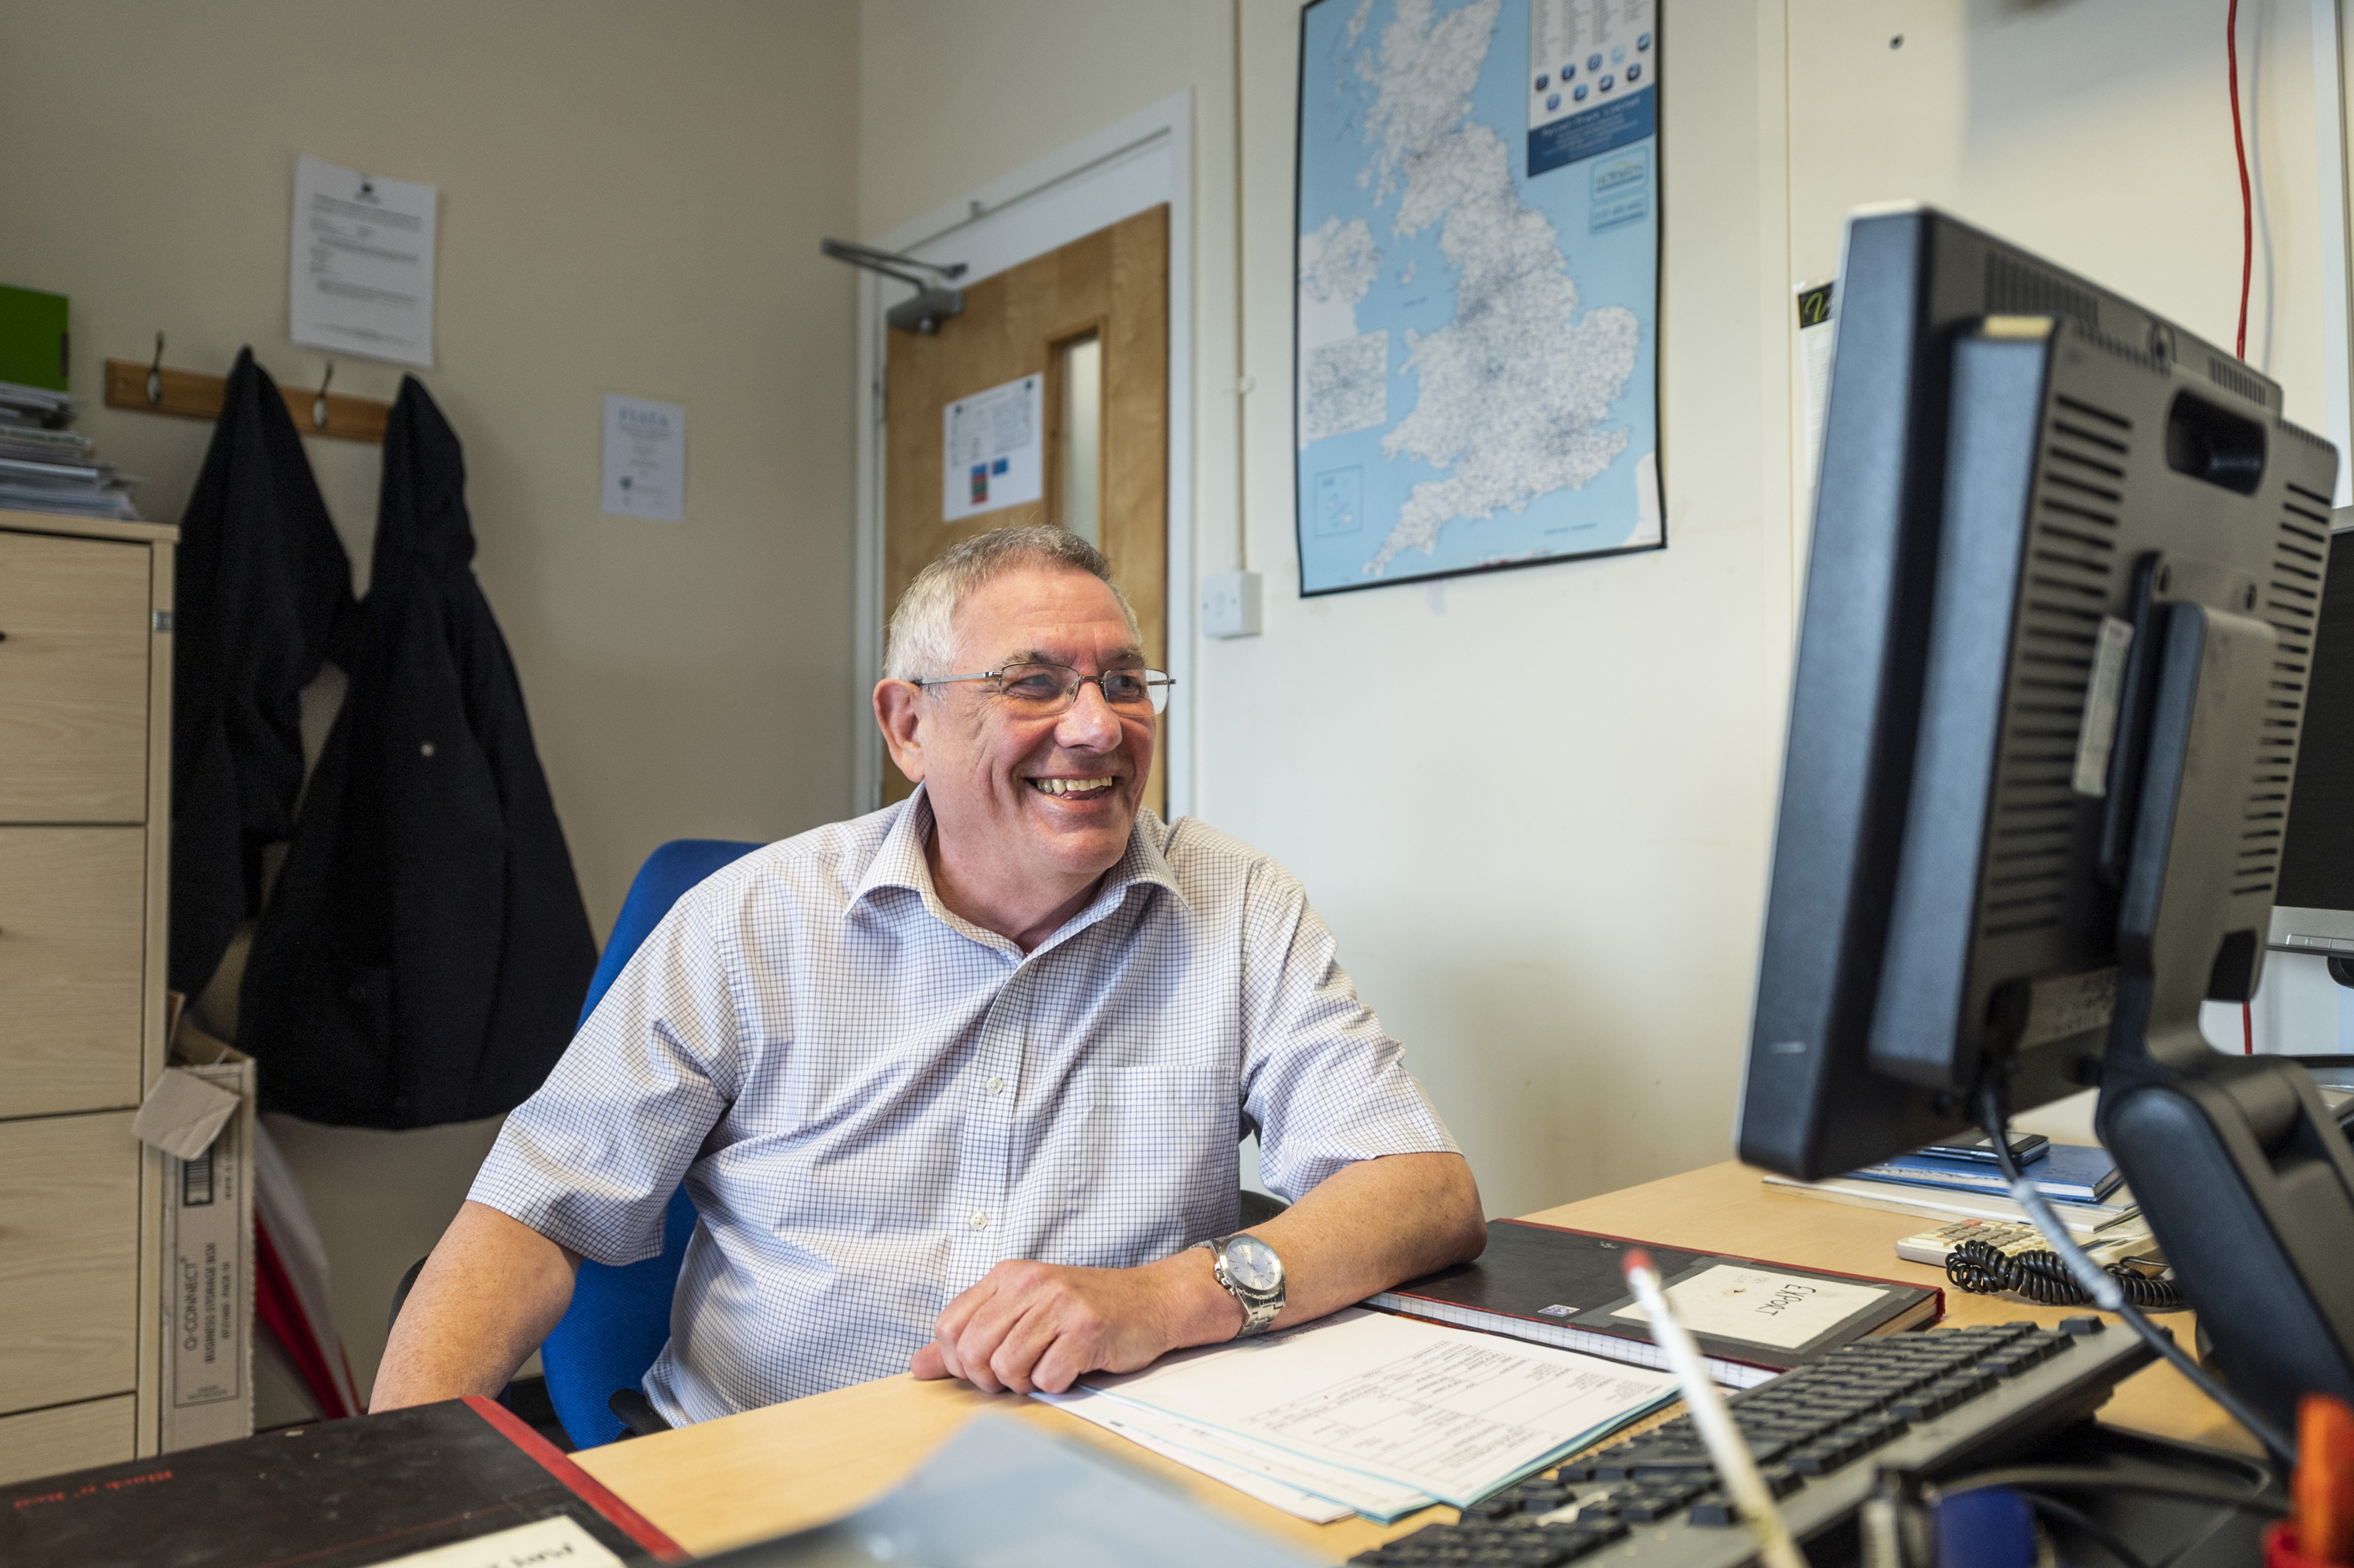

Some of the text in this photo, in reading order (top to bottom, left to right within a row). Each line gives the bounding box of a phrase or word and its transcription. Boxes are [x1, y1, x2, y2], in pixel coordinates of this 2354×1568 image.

[205, 1242, 216, 1364] BUSINESS STORAGE BOX
[1755, 1284, 1817, 1316] EXPORT
